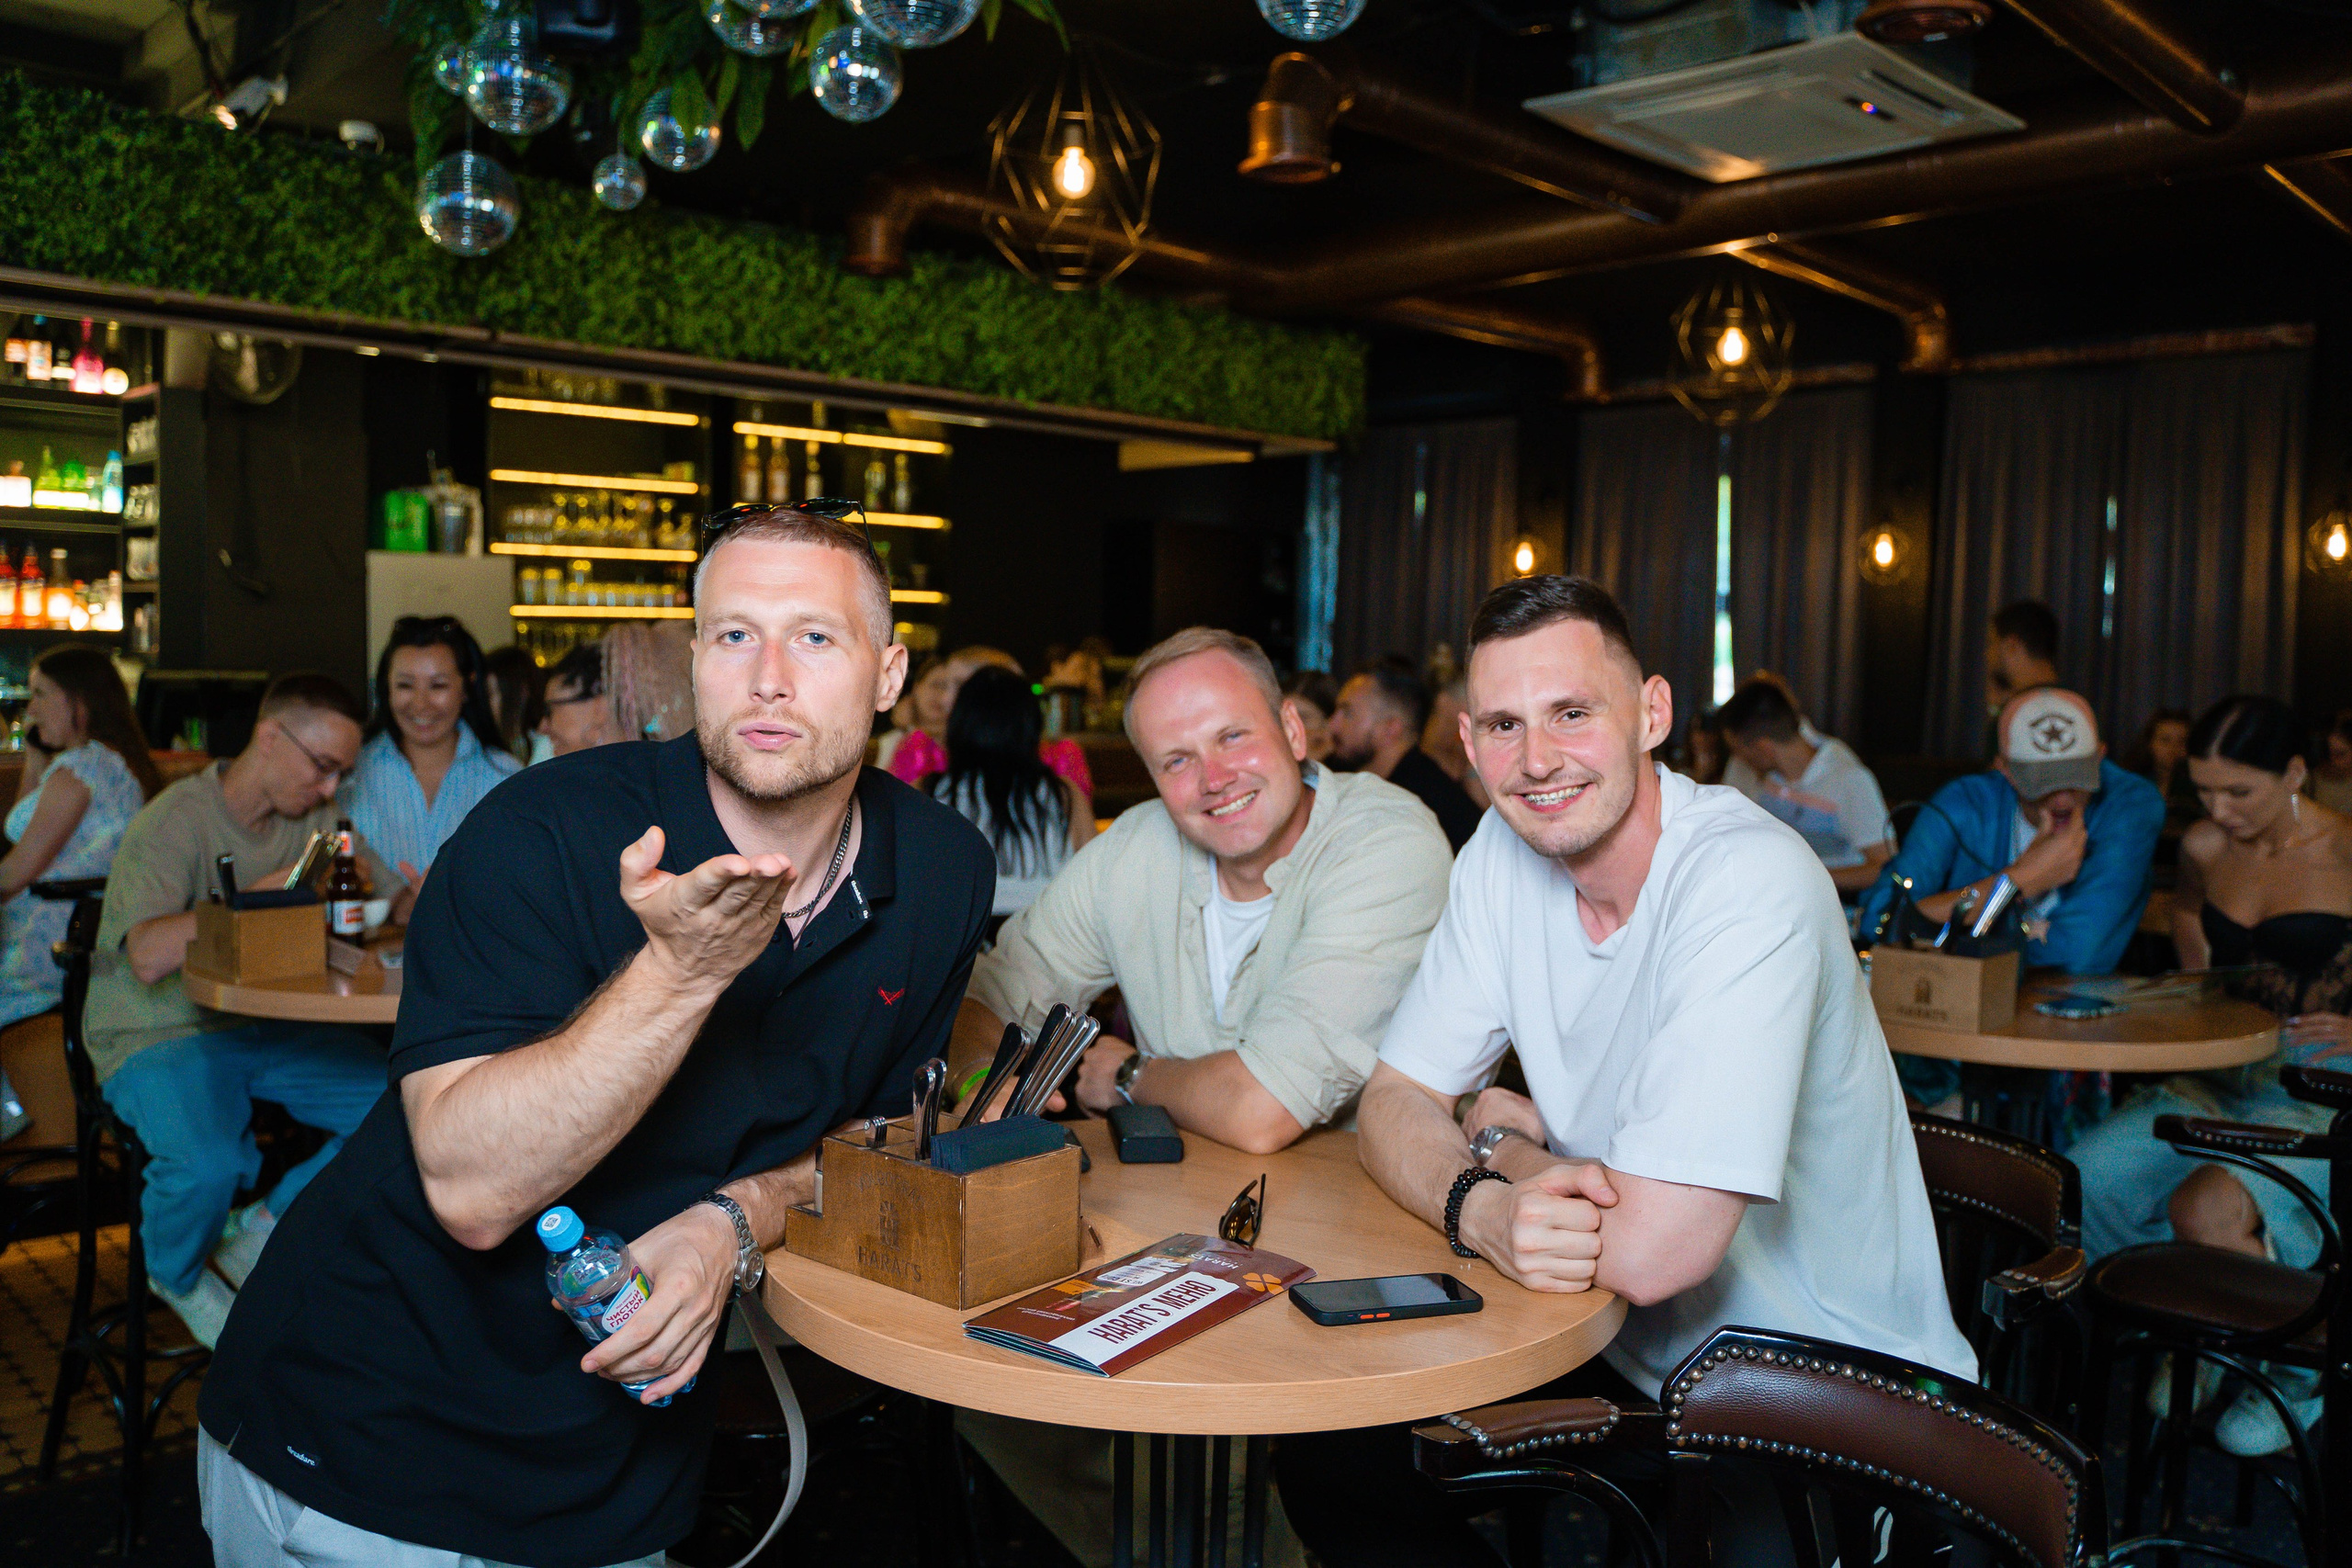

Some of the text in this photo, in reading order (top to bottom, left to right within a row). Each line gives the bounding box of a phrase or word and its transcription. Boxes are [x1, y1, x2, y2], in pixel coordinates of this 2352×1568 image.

[606, 1290, 640, 1321] ЧИСТЫЙ
[610, 1295, 644, 1328] ГЛОТОК
[1087, 1303, 1171, 1344] HARAT'S
[1150, 1280, 1216, 1310] МЕНЮ
